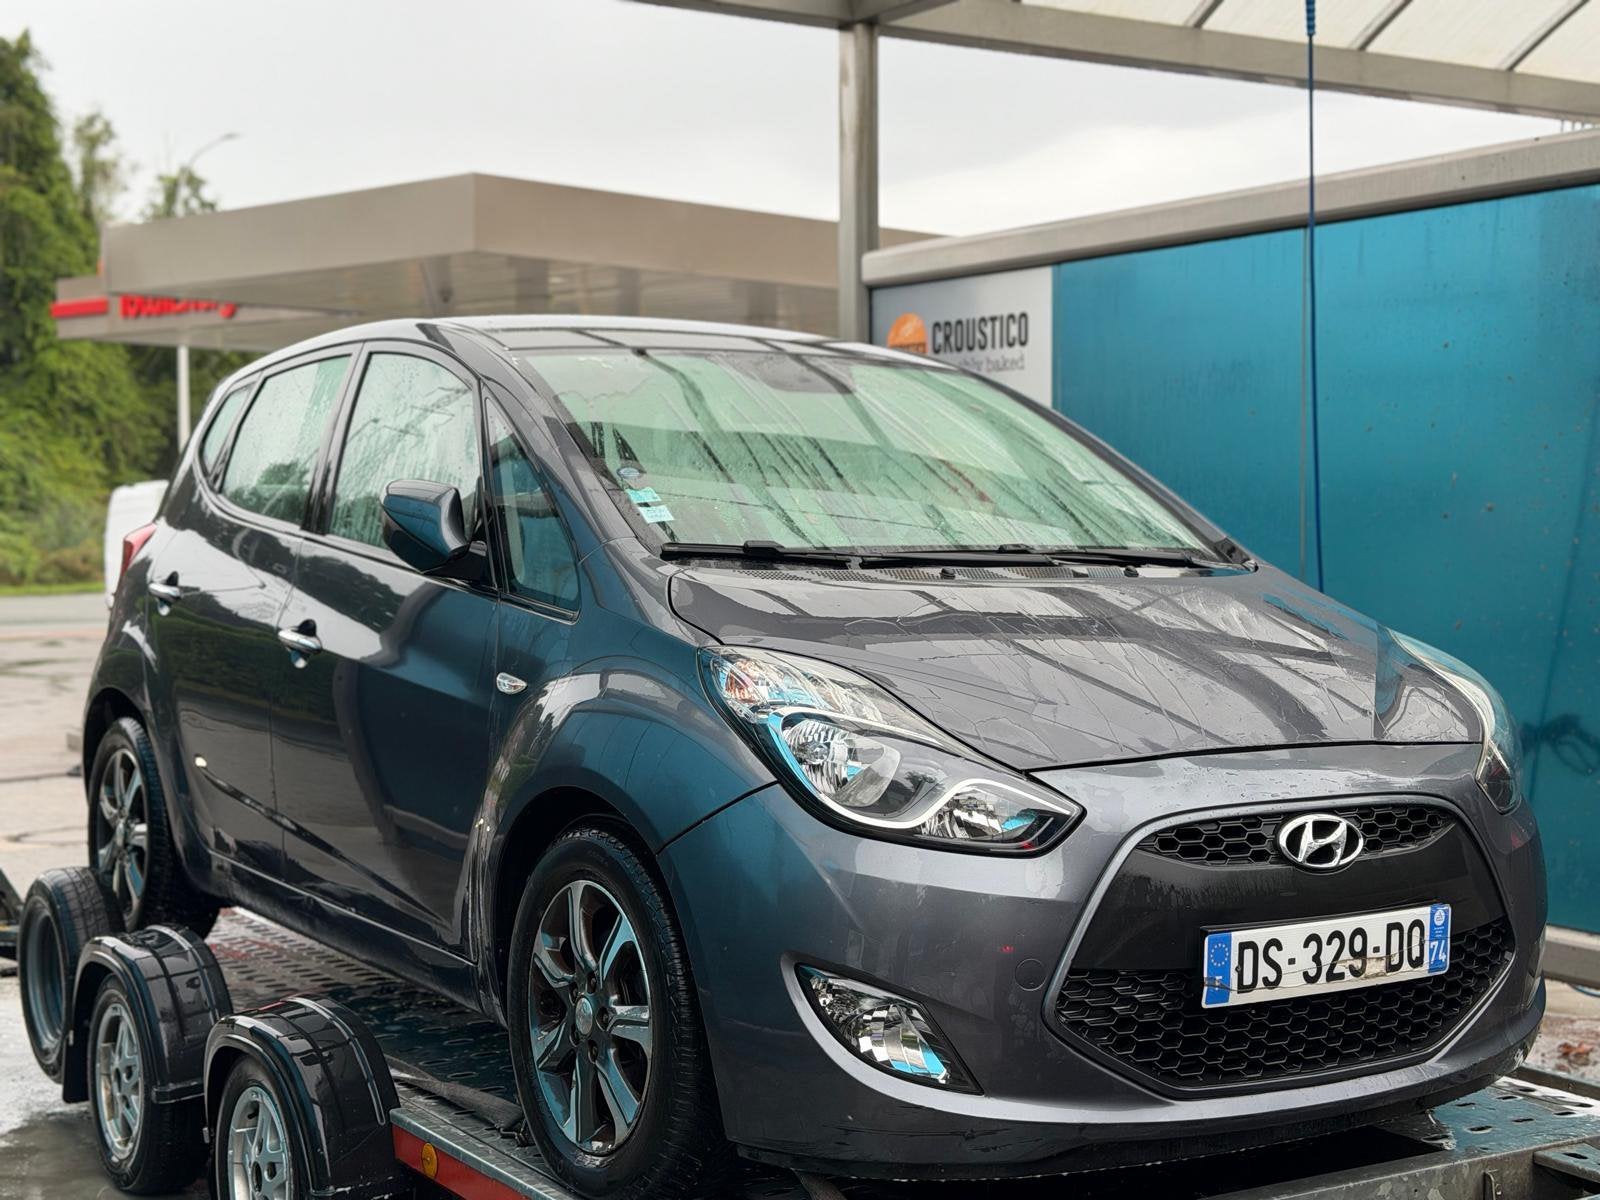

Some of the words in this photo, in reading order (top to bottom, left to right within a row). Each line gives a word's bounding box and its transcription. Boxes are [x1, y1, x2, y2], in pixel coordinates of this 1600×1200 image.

[932, 312, 1029, 354] CROUSTICO
[1236, 918, 1425, 994] DS-329-DQ
[1430, 939, 1447, 965] 74
